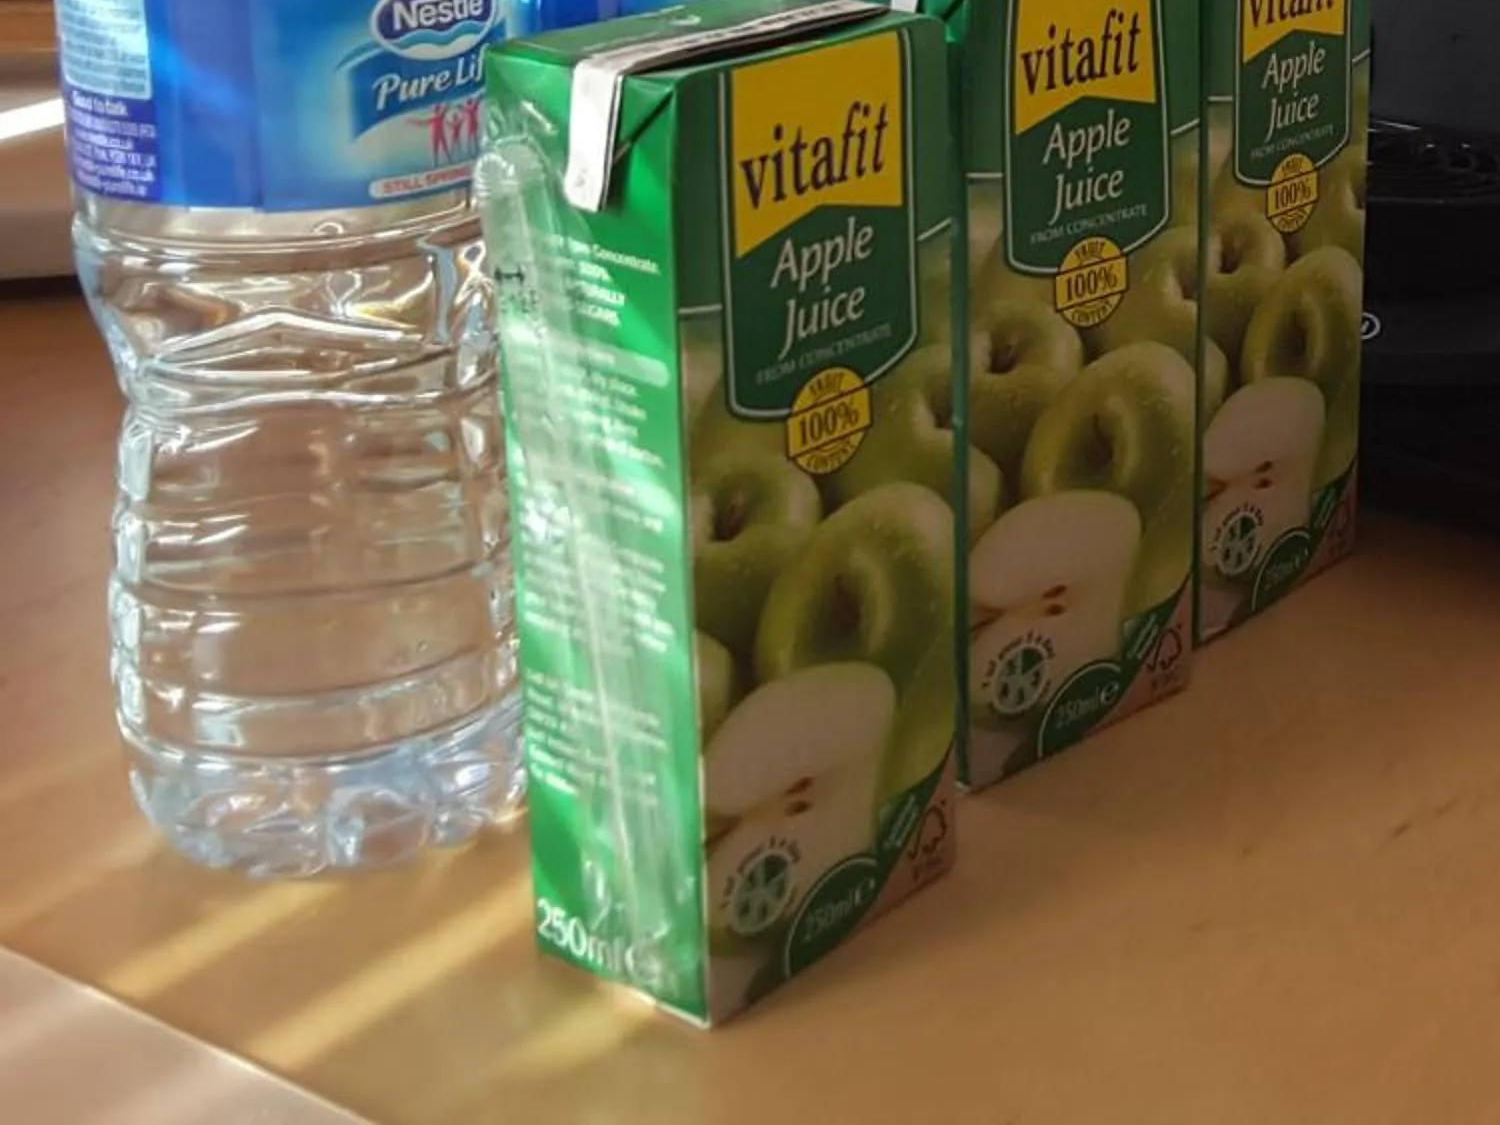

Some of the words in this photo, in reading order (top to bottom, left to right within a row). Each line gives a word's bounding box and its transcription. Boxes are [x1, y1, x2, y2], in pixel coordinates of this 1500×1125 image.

[372, 69, 452, 112] Pure
[456, 42, 488, 87] Lif
[1020, 7, 1142, 96] vitafit
[1262, 40, 1327, 91] Apple
[1042, 108, 1132, 170] Apple
[1263, 90, 1320, 143] Juice
[738, 98, 890, 211] vitafit
[1048, 165, 1125, 226] Juice
[1273, 180, 1312, 213] 100%
[769, 215, 875, 292] Apple
[1064, 265, 1118, 301] 100%
[778, 284, 866, 361] Juice
[798, 403, 861, 447] 100%
